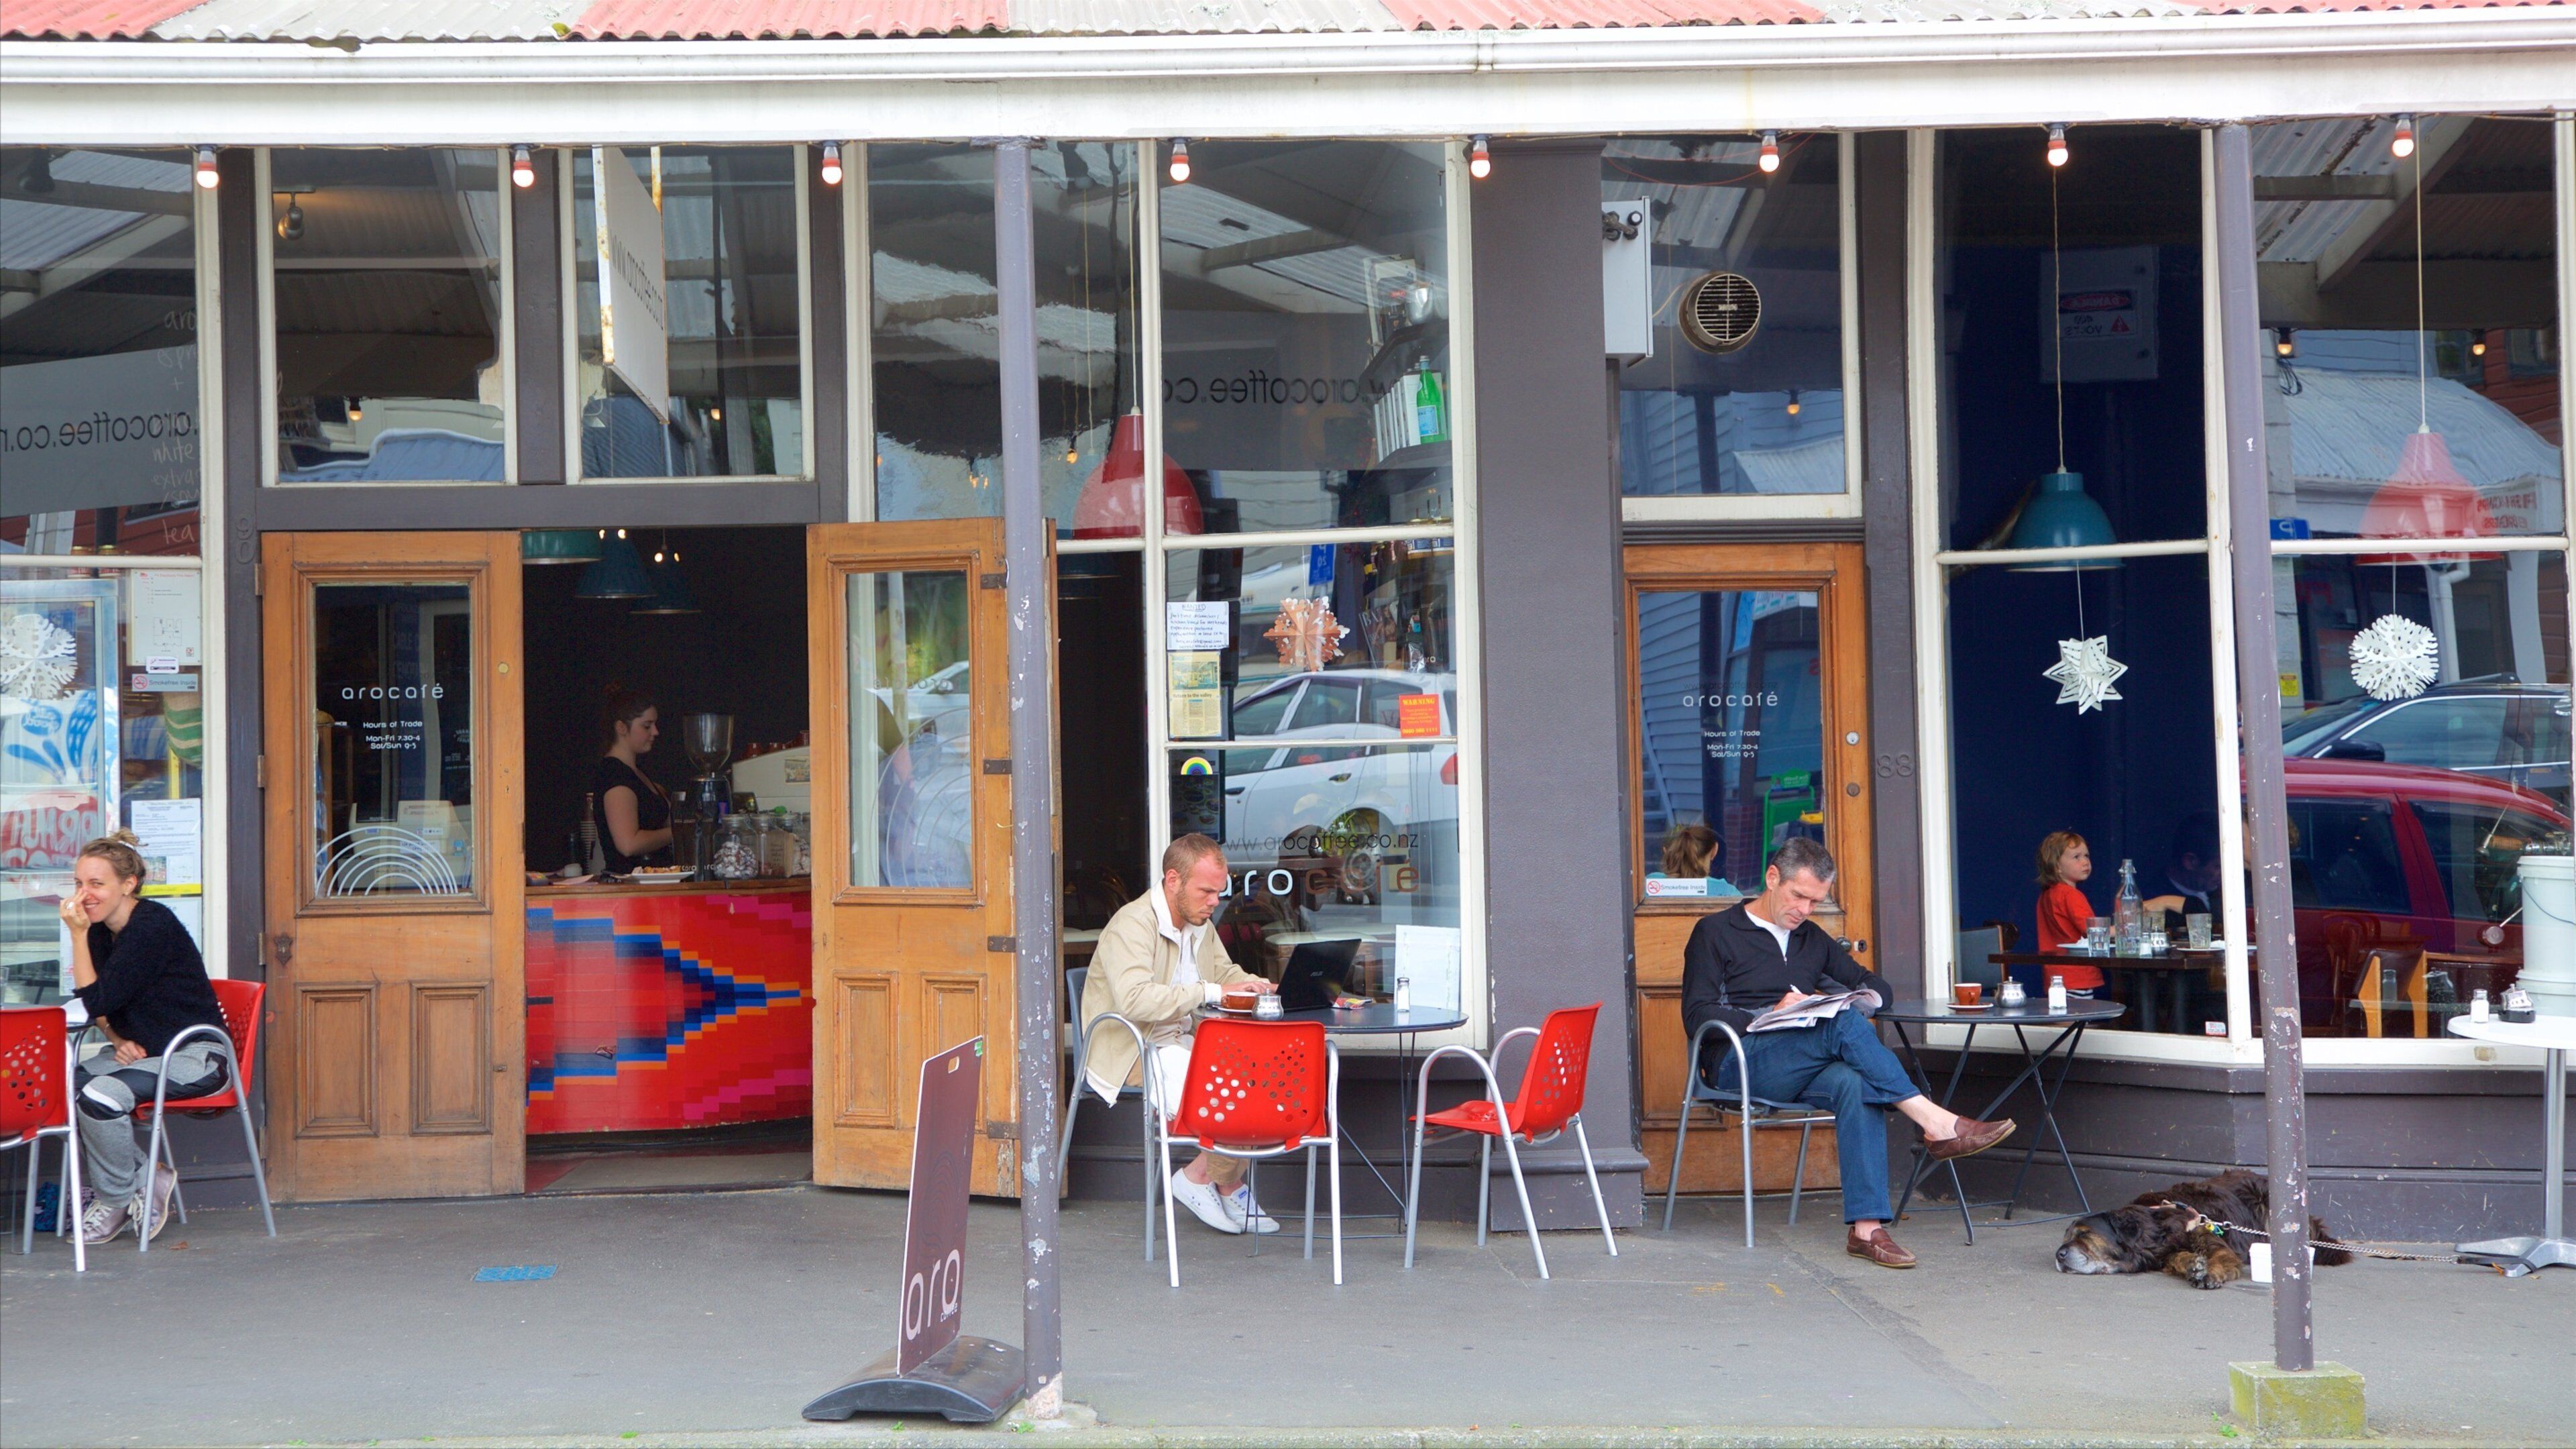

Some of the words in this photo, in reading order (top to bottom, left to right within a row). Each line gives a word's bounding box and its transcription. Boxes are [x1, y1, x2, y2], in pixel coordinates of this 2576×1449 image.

[1403, 698, 1435, 706] WARNING
[1877, 752, 1915, 778] 88
[906, 1249, 960, 1340] aro
